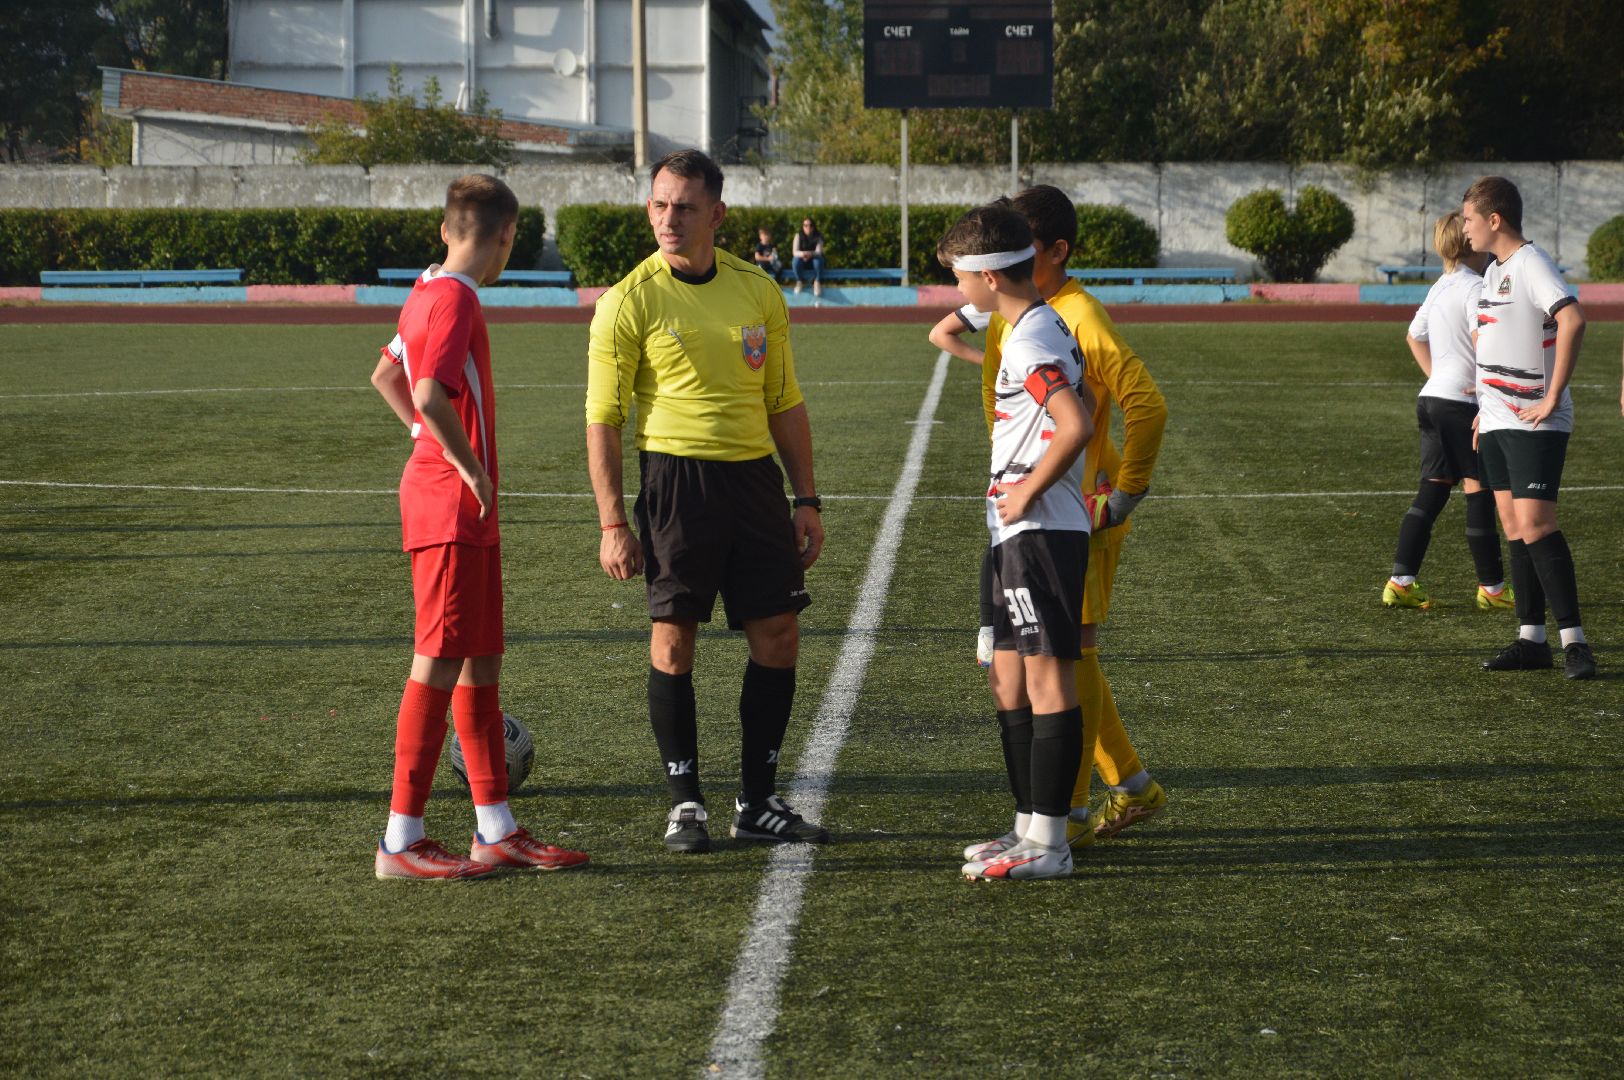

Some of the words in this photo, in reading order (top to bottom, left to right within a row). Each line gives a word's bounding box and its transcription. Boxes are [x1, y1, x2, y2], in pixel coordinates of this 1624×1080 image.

[884, 25, 913, 38] СЧЕТ
[1005, 24, 1034, 37] СЧЕТ
[1004, 587, 1039, 626] 30
[667, 758, 693, 776] 2K
